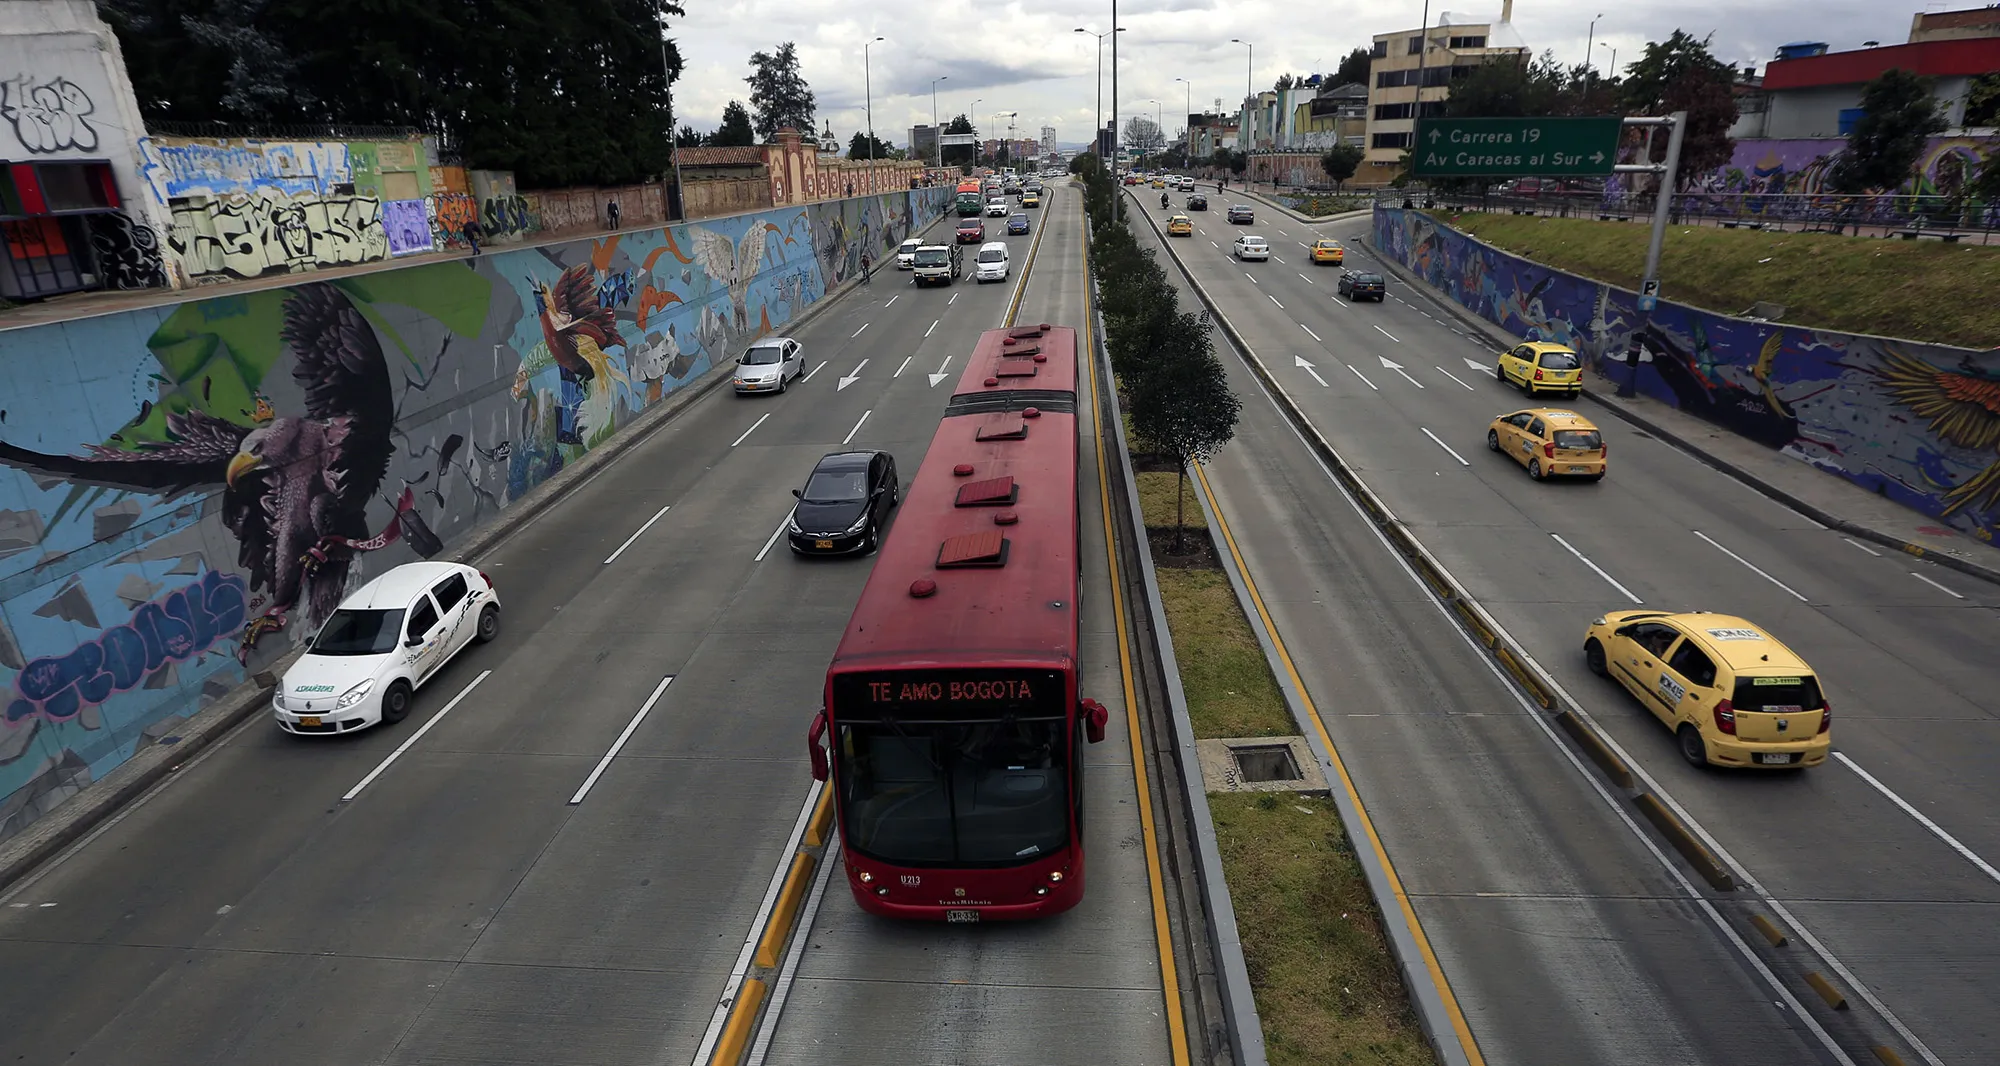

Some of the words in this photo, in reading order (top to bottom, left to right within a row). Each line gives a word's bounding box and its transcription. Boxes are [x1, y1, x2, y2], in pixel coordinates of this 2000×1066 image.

[1450, 129, 1513, 143] Carrera
[1521, 128, 1541, 143] 19
[1424, 152, 1447, 166] Av
[1456, 152, 1521, 166] Caracas
[1530, 152, 1544, 166] al
[1552, 151, 1583, 166] Sur
[869, 682, 891, 701] TE
[900, 682, 942, 700] AMO
[950, 680, 1032, 700] BOGOTA
